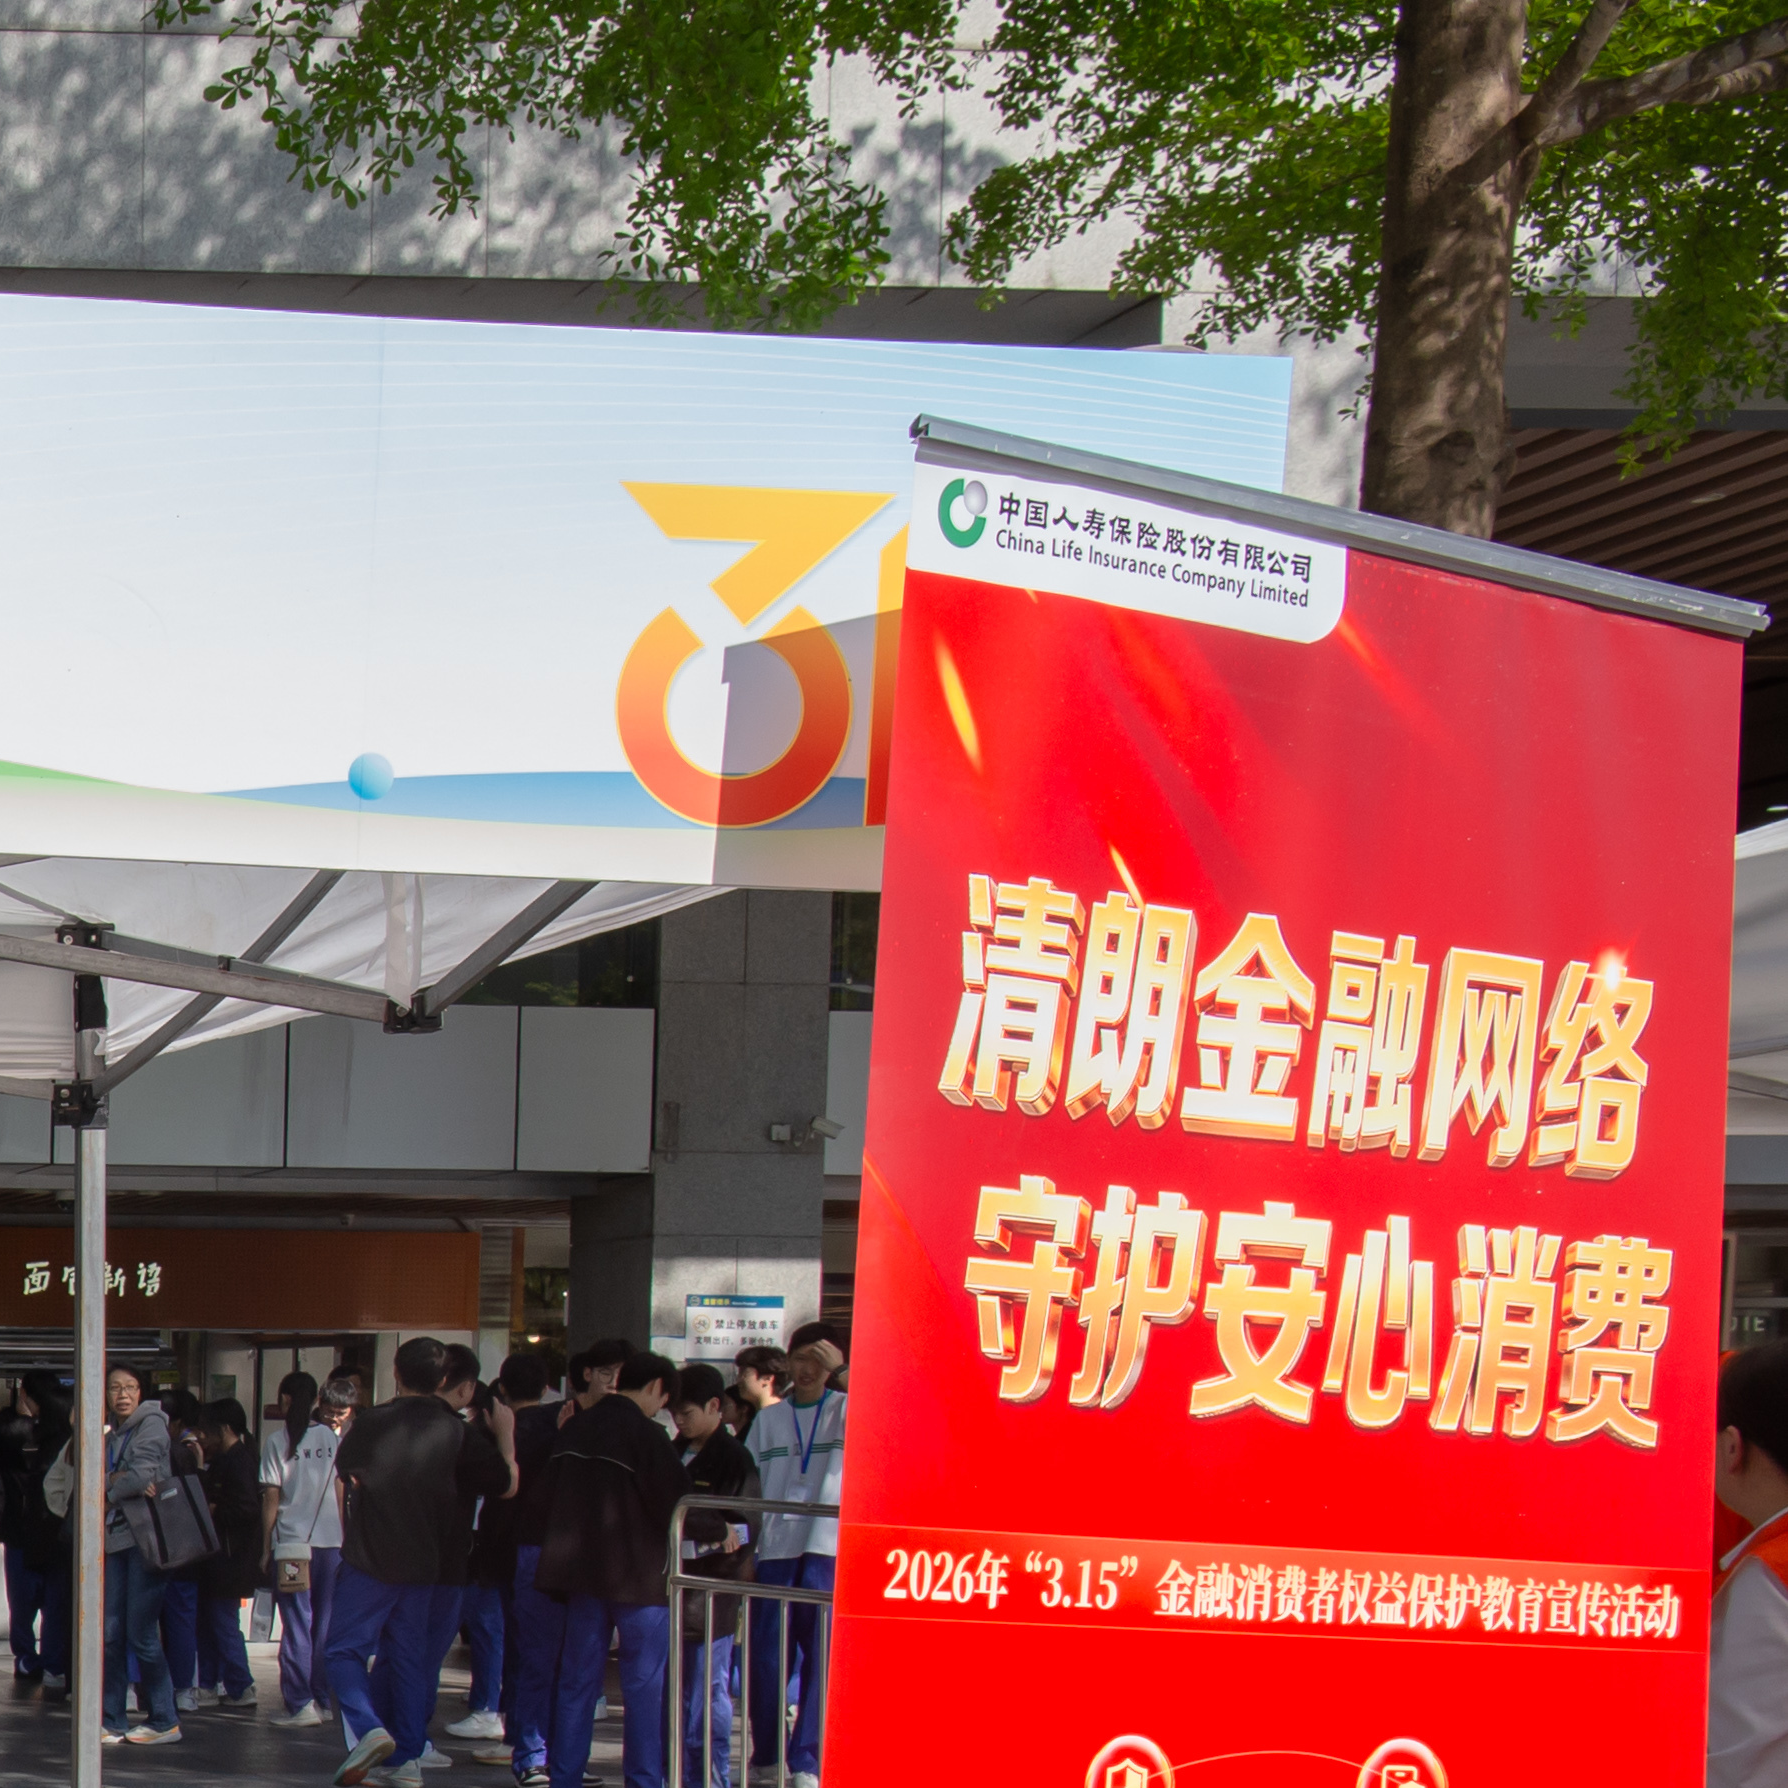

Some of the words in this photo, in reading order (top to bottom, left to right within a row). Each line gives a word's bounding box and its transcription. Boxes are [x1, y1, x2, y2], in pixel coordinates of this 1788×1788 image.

[996, 528, 1045, 557] China
[1051, 540, 1083, 563] Life
[1089, 544, 1167, 580] Insurance
[1172, 563, 1246, 598] Company
[1250, 577, 1309, 608] Limited
[998, 491, 1312, 583] 中国人寿保险股份有限公司
[938, 871, 1656, 1182] 清朗金融网络
[964, 1173, 1674, 1451] 守护安心消费
